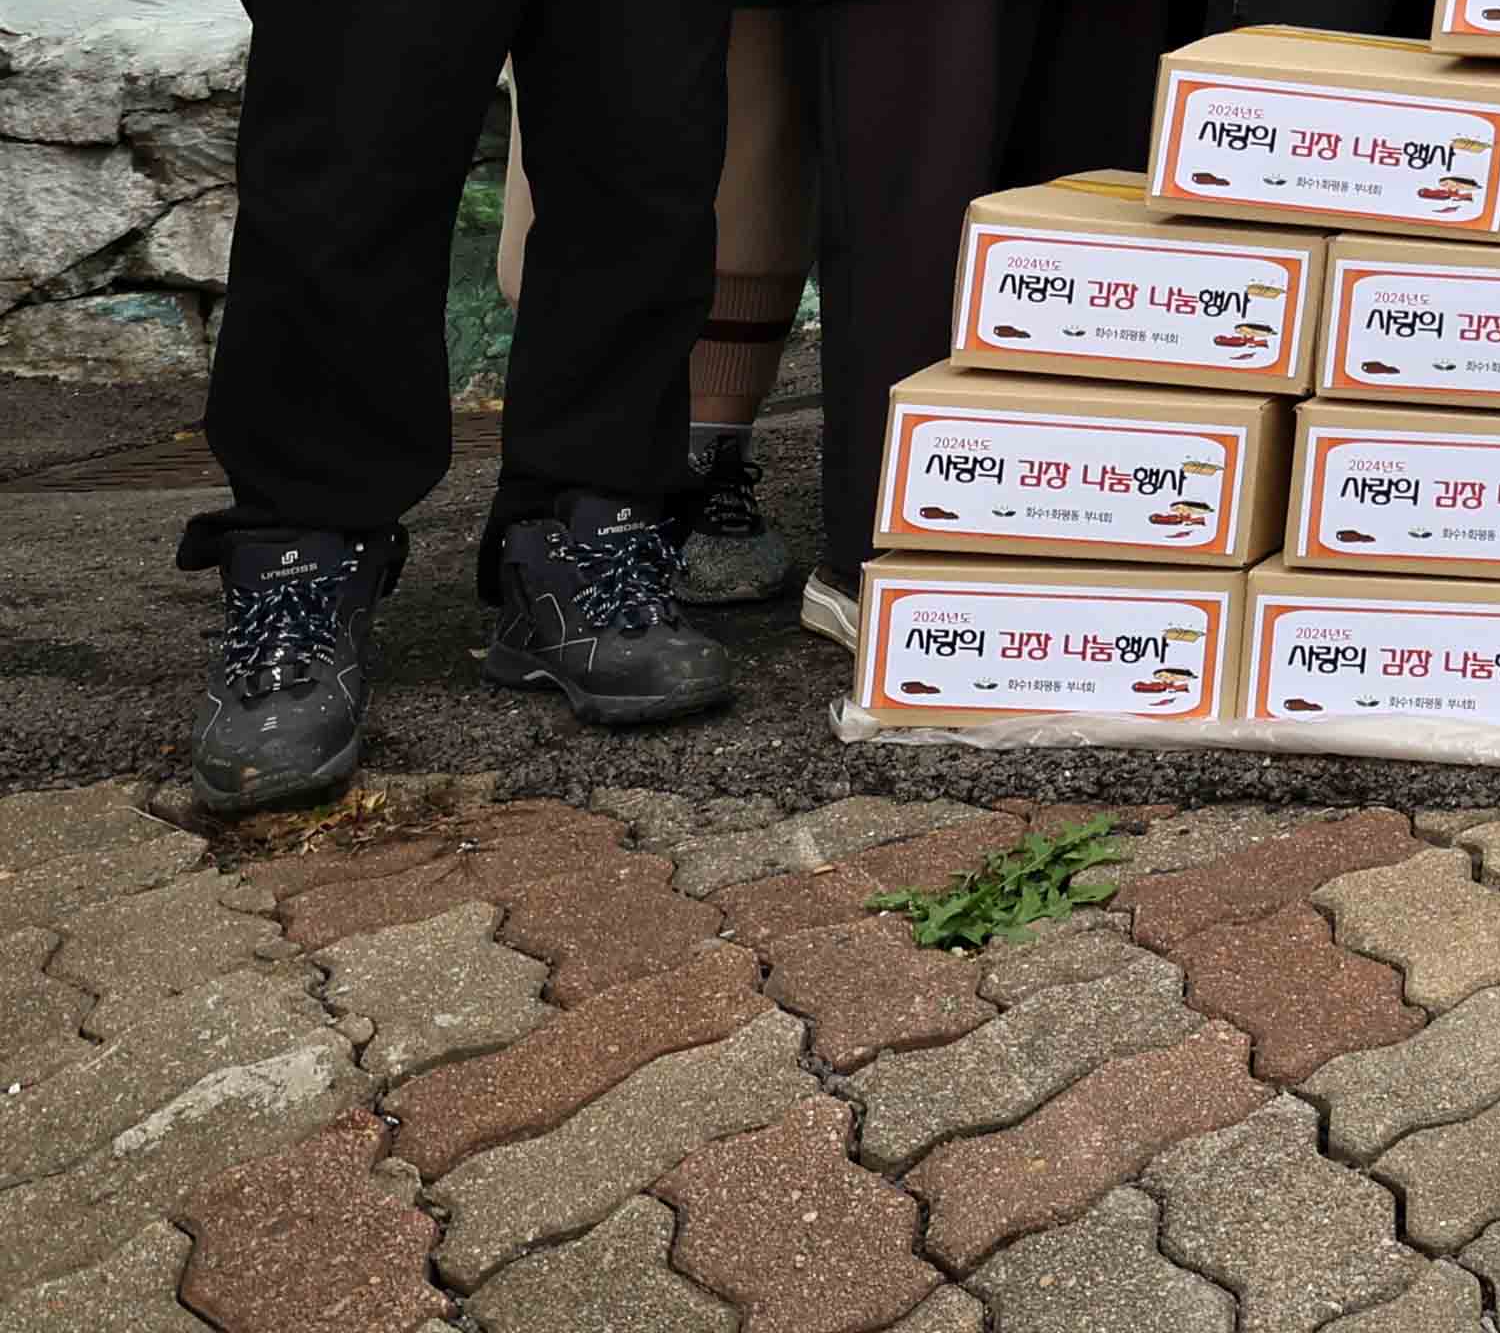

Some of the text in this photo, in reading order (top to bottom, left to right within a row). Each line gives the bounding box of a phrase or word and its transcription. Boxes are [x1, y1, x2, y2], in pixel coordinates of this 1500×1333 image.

[1198, 120, 1278, 155] 사랑의
[1290, 129, 1344, 162] 김장
[1006, 256, 1063, 273] 2024년도
[998, 273, 1076, 306] 사랑의
[1088, 280, 1140, 311] 김장
[933, 436, 992, 453] 2024년도
[924, 454, 1006, 486] 사랑의
[1018, 460, 1072, 491] 김장
[1348, 459, 1407, 475] 2024년도
[1340, 476, 1421, 508] 사랑의
[1433, 480, 1488, 511] 김장
[912, 610, 972, 626] 2024년도
[905, 628, 986, 659] 사랑의
[999, 631, 1053, 662] 김장
